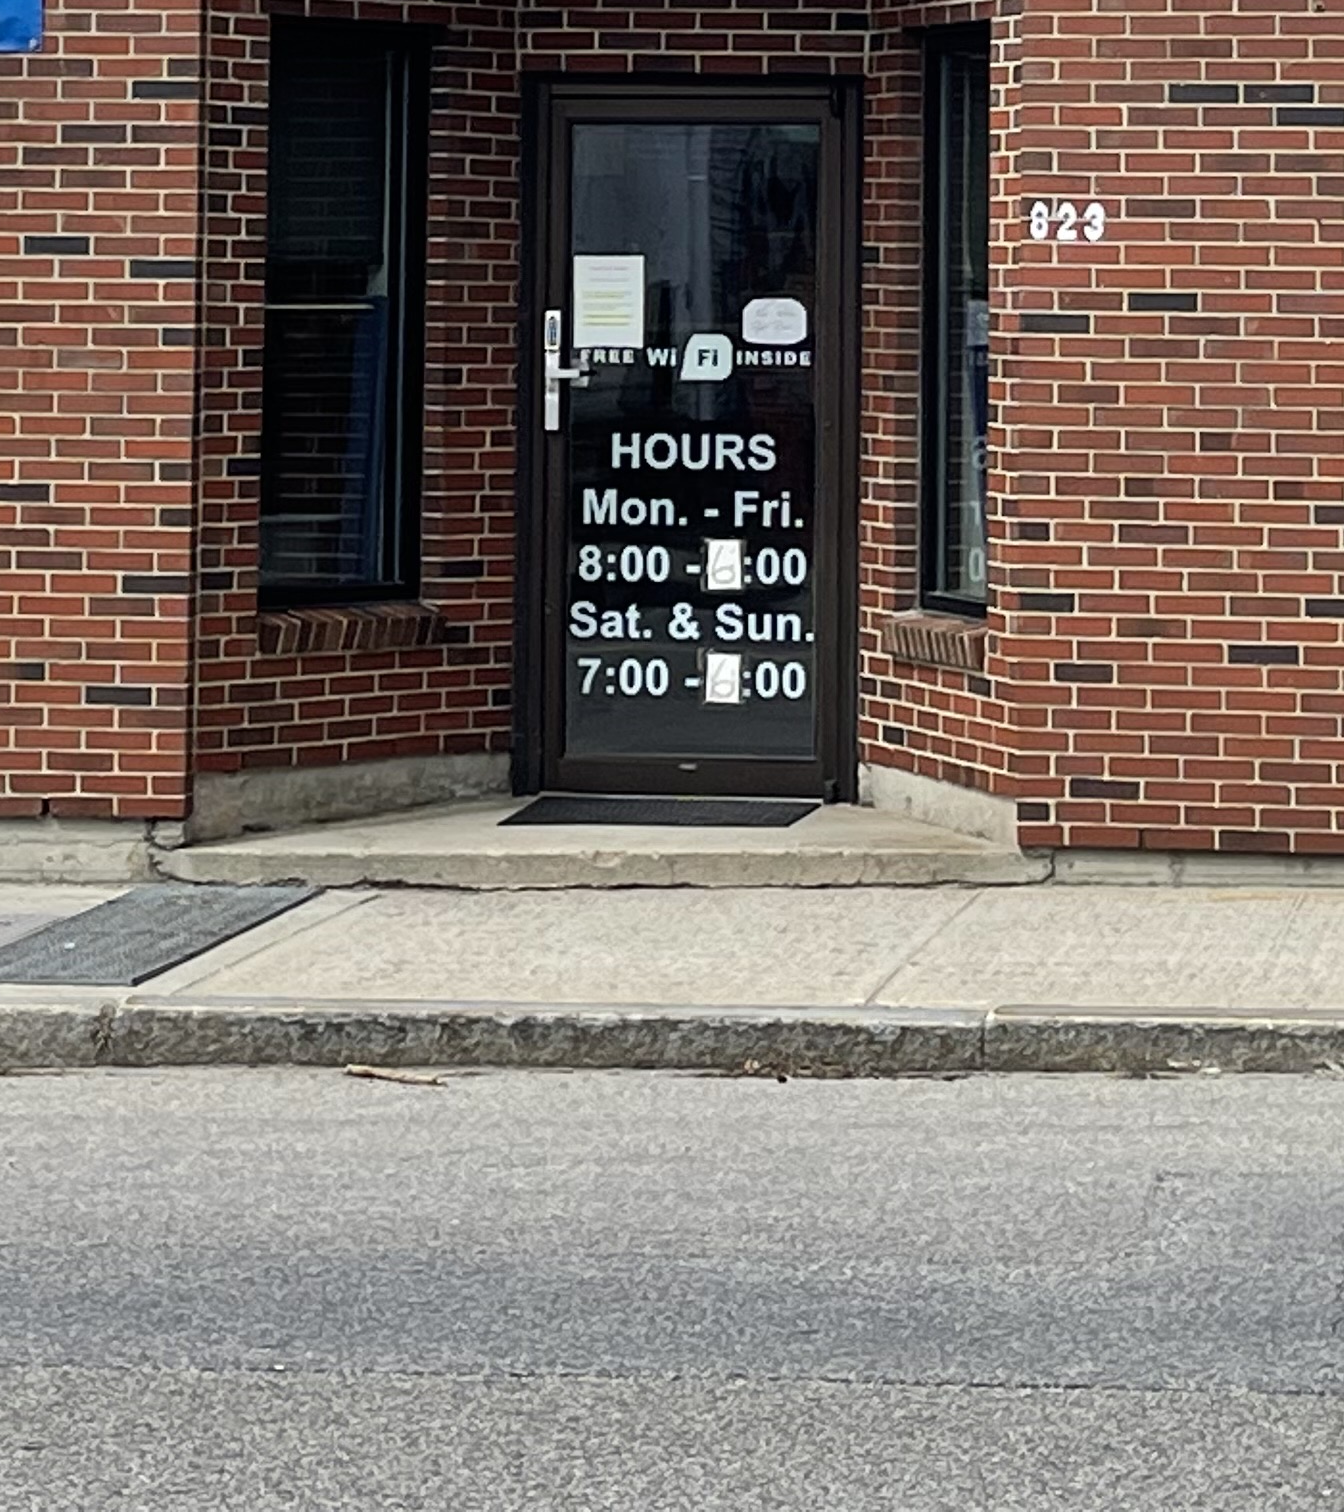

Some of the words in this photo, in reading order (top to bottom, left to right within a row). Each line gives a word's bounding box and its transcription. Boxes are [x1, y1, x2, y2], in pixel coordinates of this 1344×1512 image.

[1030, 200, 1106, 241] 823
[736, 350, 813, 366] INSIDE
[611, 432, 776, 471] HOURS
[582, 488, 688, 526] Mon.
[734, 490, 804, 528] Fri.
[578, 544, 671, 583] 8:00
[710, 543, 807, 585] 6:00
[569, 600, 653, 639] Sat.
[667, 601, 700, 640] &
[714, 603, 815, 642] Sun.
[576, 657, 669, 696] 7:00
